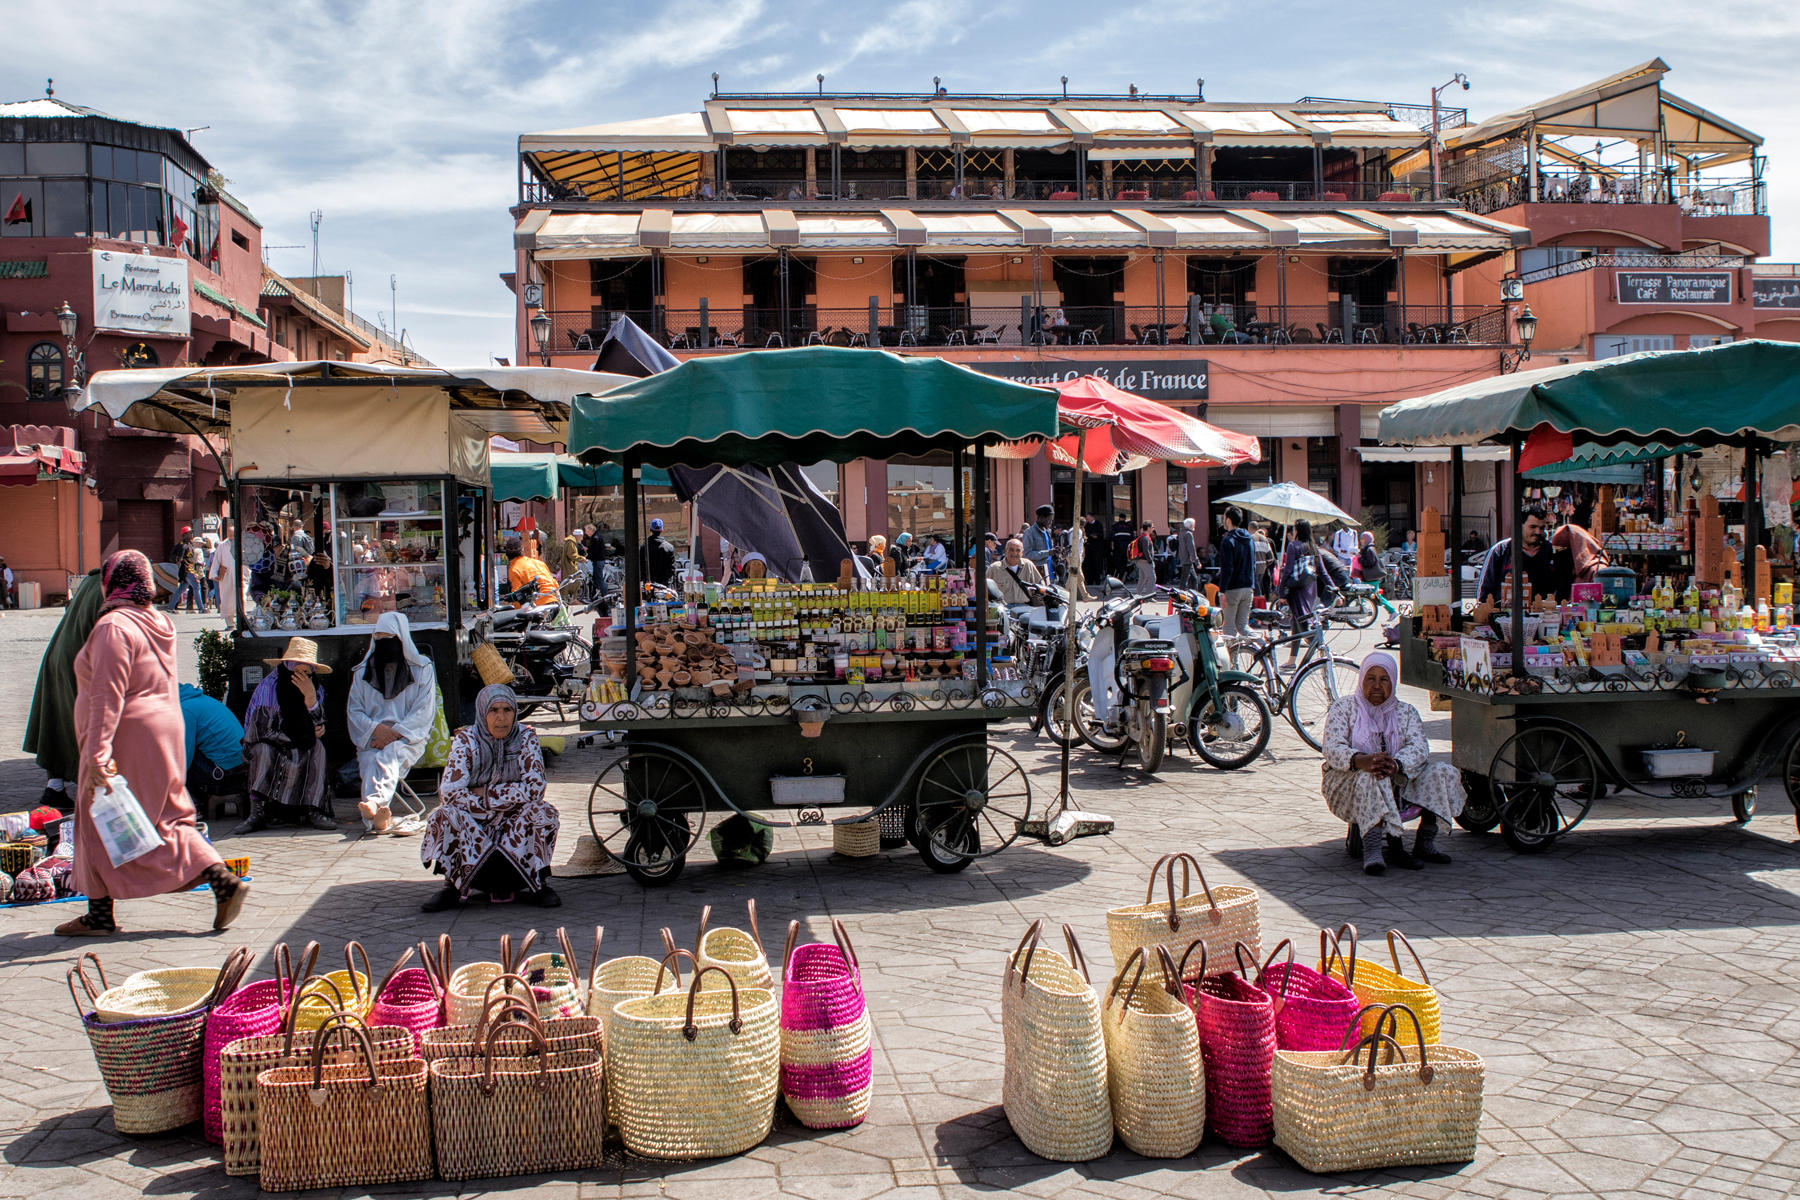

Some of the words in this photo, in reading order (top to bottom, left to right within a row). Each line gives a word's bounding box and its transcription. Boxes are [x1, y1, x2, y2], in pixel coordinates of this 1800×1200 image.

[124, 263, 160, 274] Restaurant
[101, 273, 120, 289] Le
[121, 275, 181, 295] Marrakchi
[1625, 275, 1662, 288] Terrasse
[1666, 275, 1727, 289] Panoramique
[1637, 288, 1658, 300] Café
[1671, 287, 1716, 300] Restaurant
[110, 309, 142, 320] Brasserie
[142, 312, 174, 322] Orientale
[1064, 367, 1109, 383] Cfé
[1114, 367, 1137, 390] de
[1140, 369, 1208, 391] France
[1676, 730, 1686, 747] 2
[802, 757, 813, 775] 3
